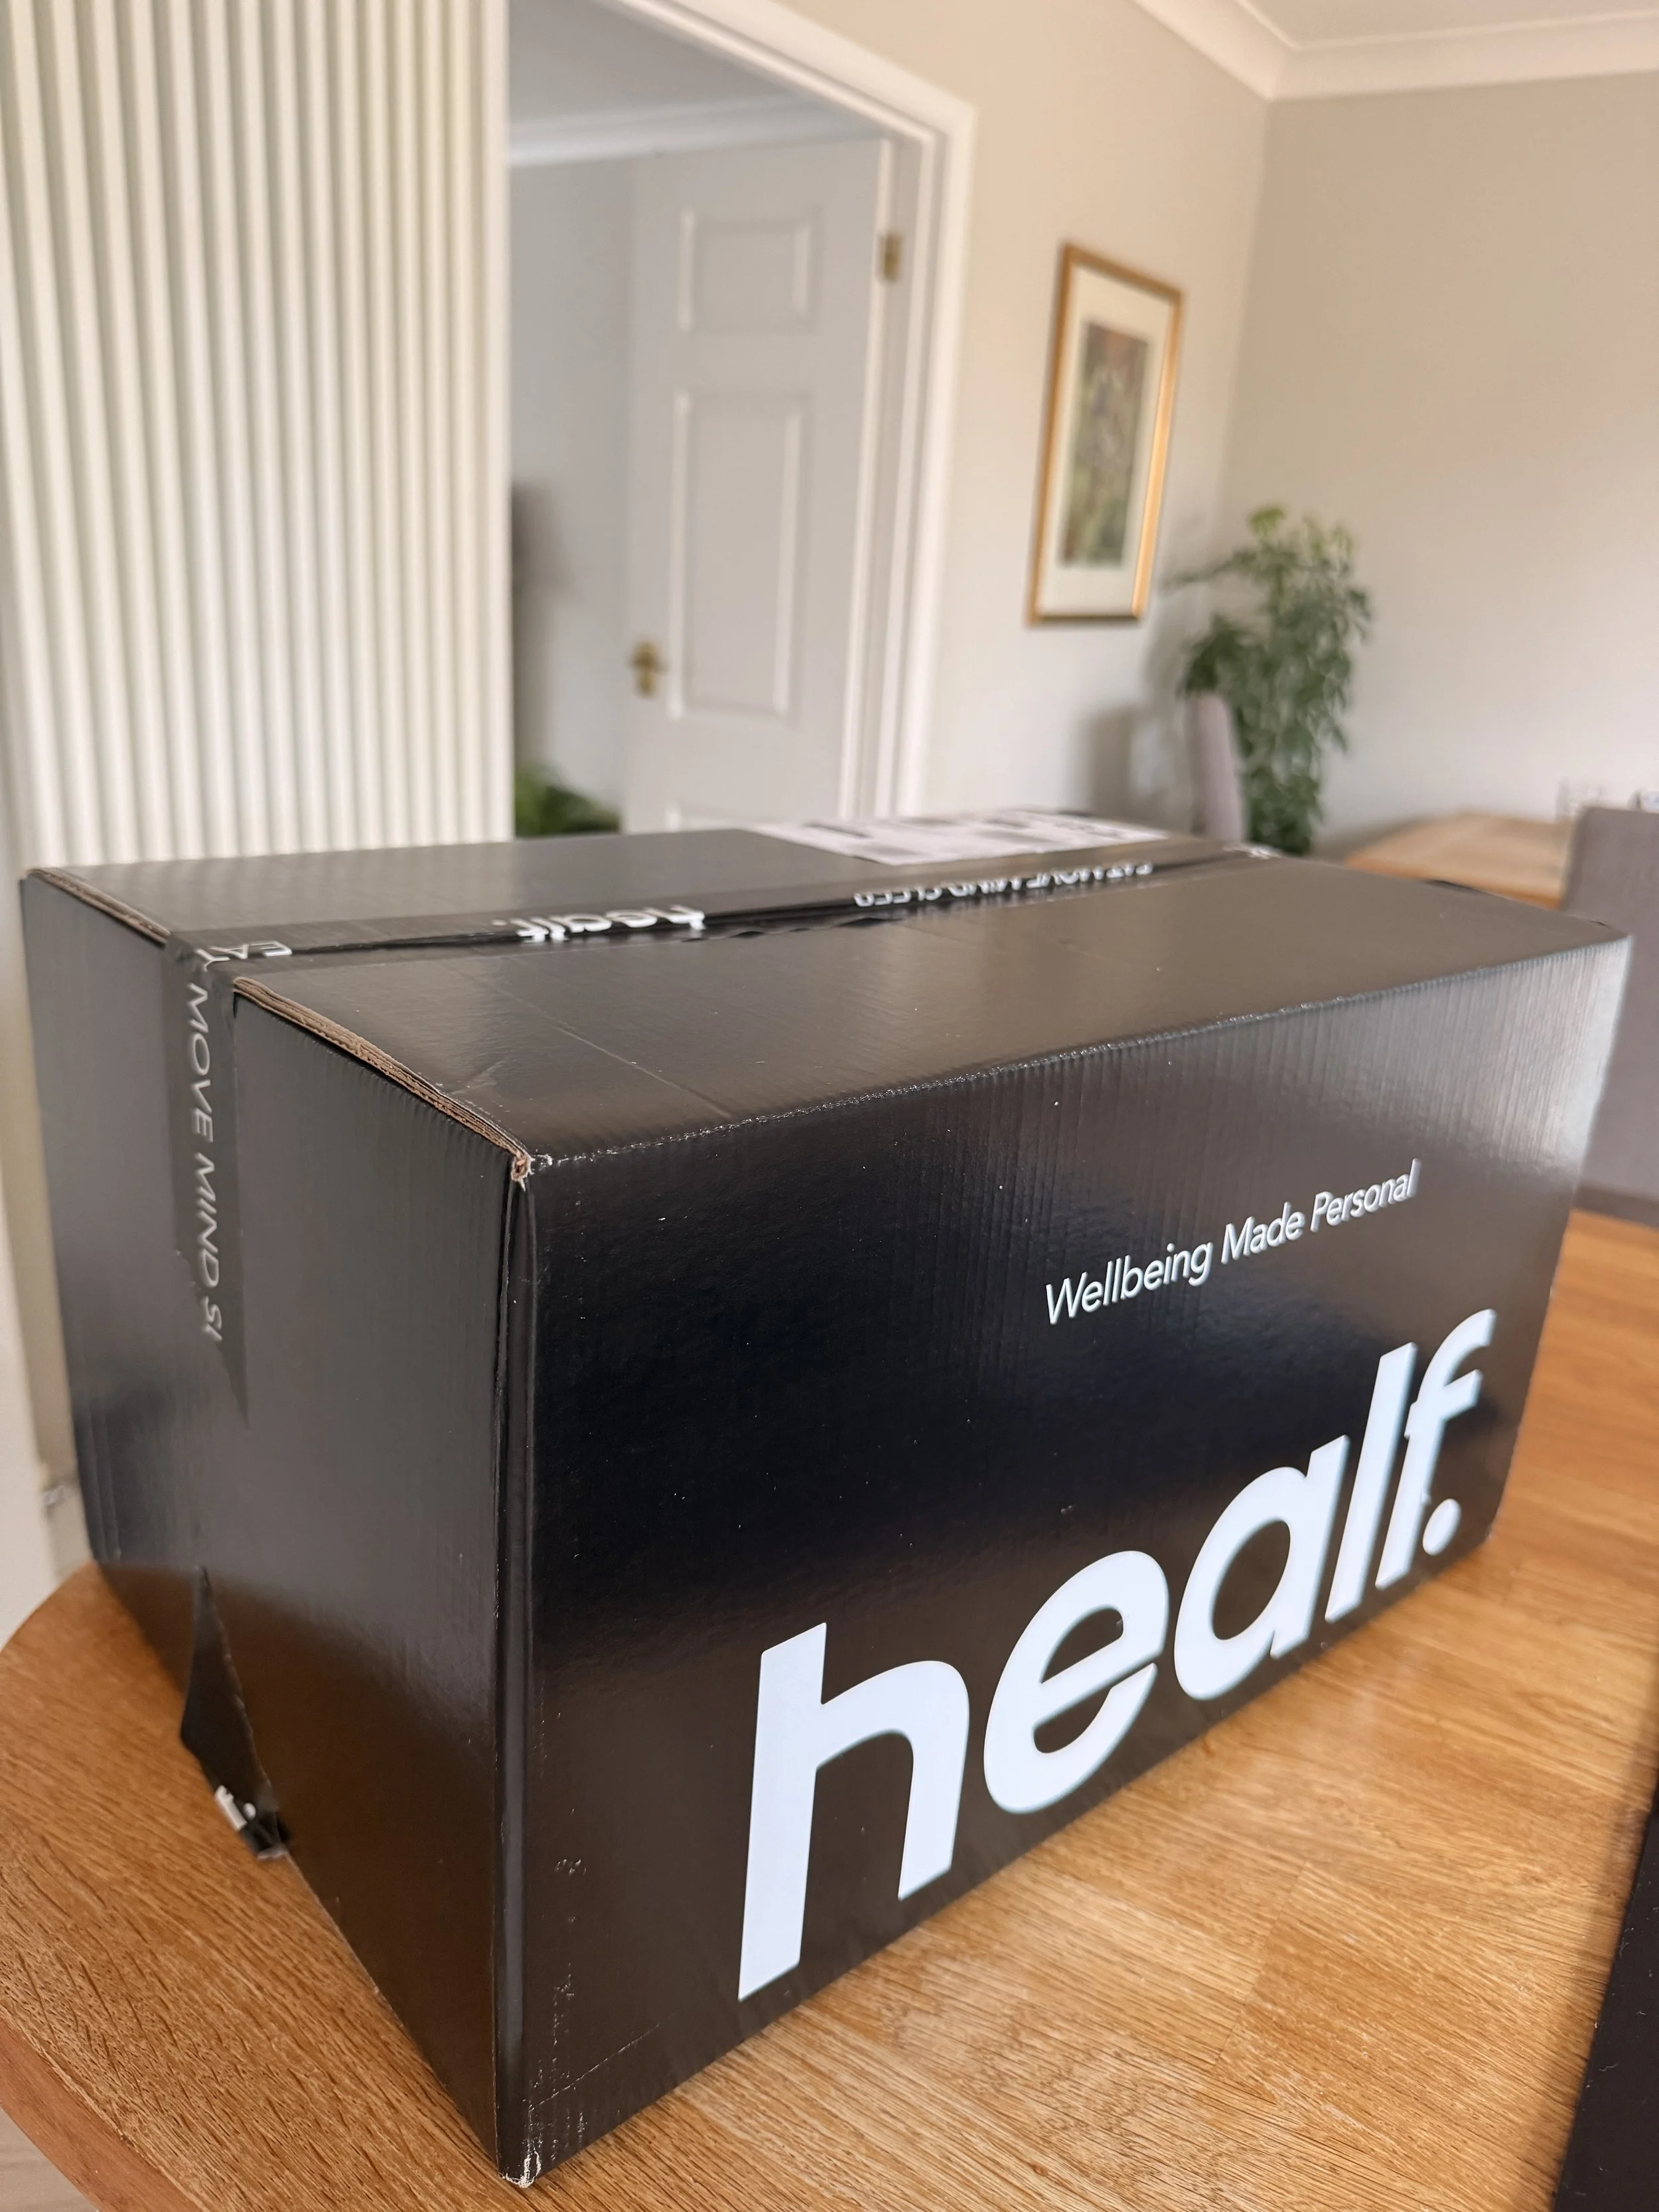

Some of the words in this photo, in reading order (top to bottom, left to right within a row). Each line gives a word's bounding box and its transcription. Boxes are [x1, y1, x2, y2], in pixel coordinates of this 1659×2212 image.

[187, 982, 214, 1142] MOVE
[195, 1152, 220, 1288] MIND
[1045, 1243, 1213, 1325] Wellbeing
[1220, 1202, 1306, 1264] Made
[1311, 1157, 1421, 1232] Personal
[738, 1307, 1496, 2002] healf.
